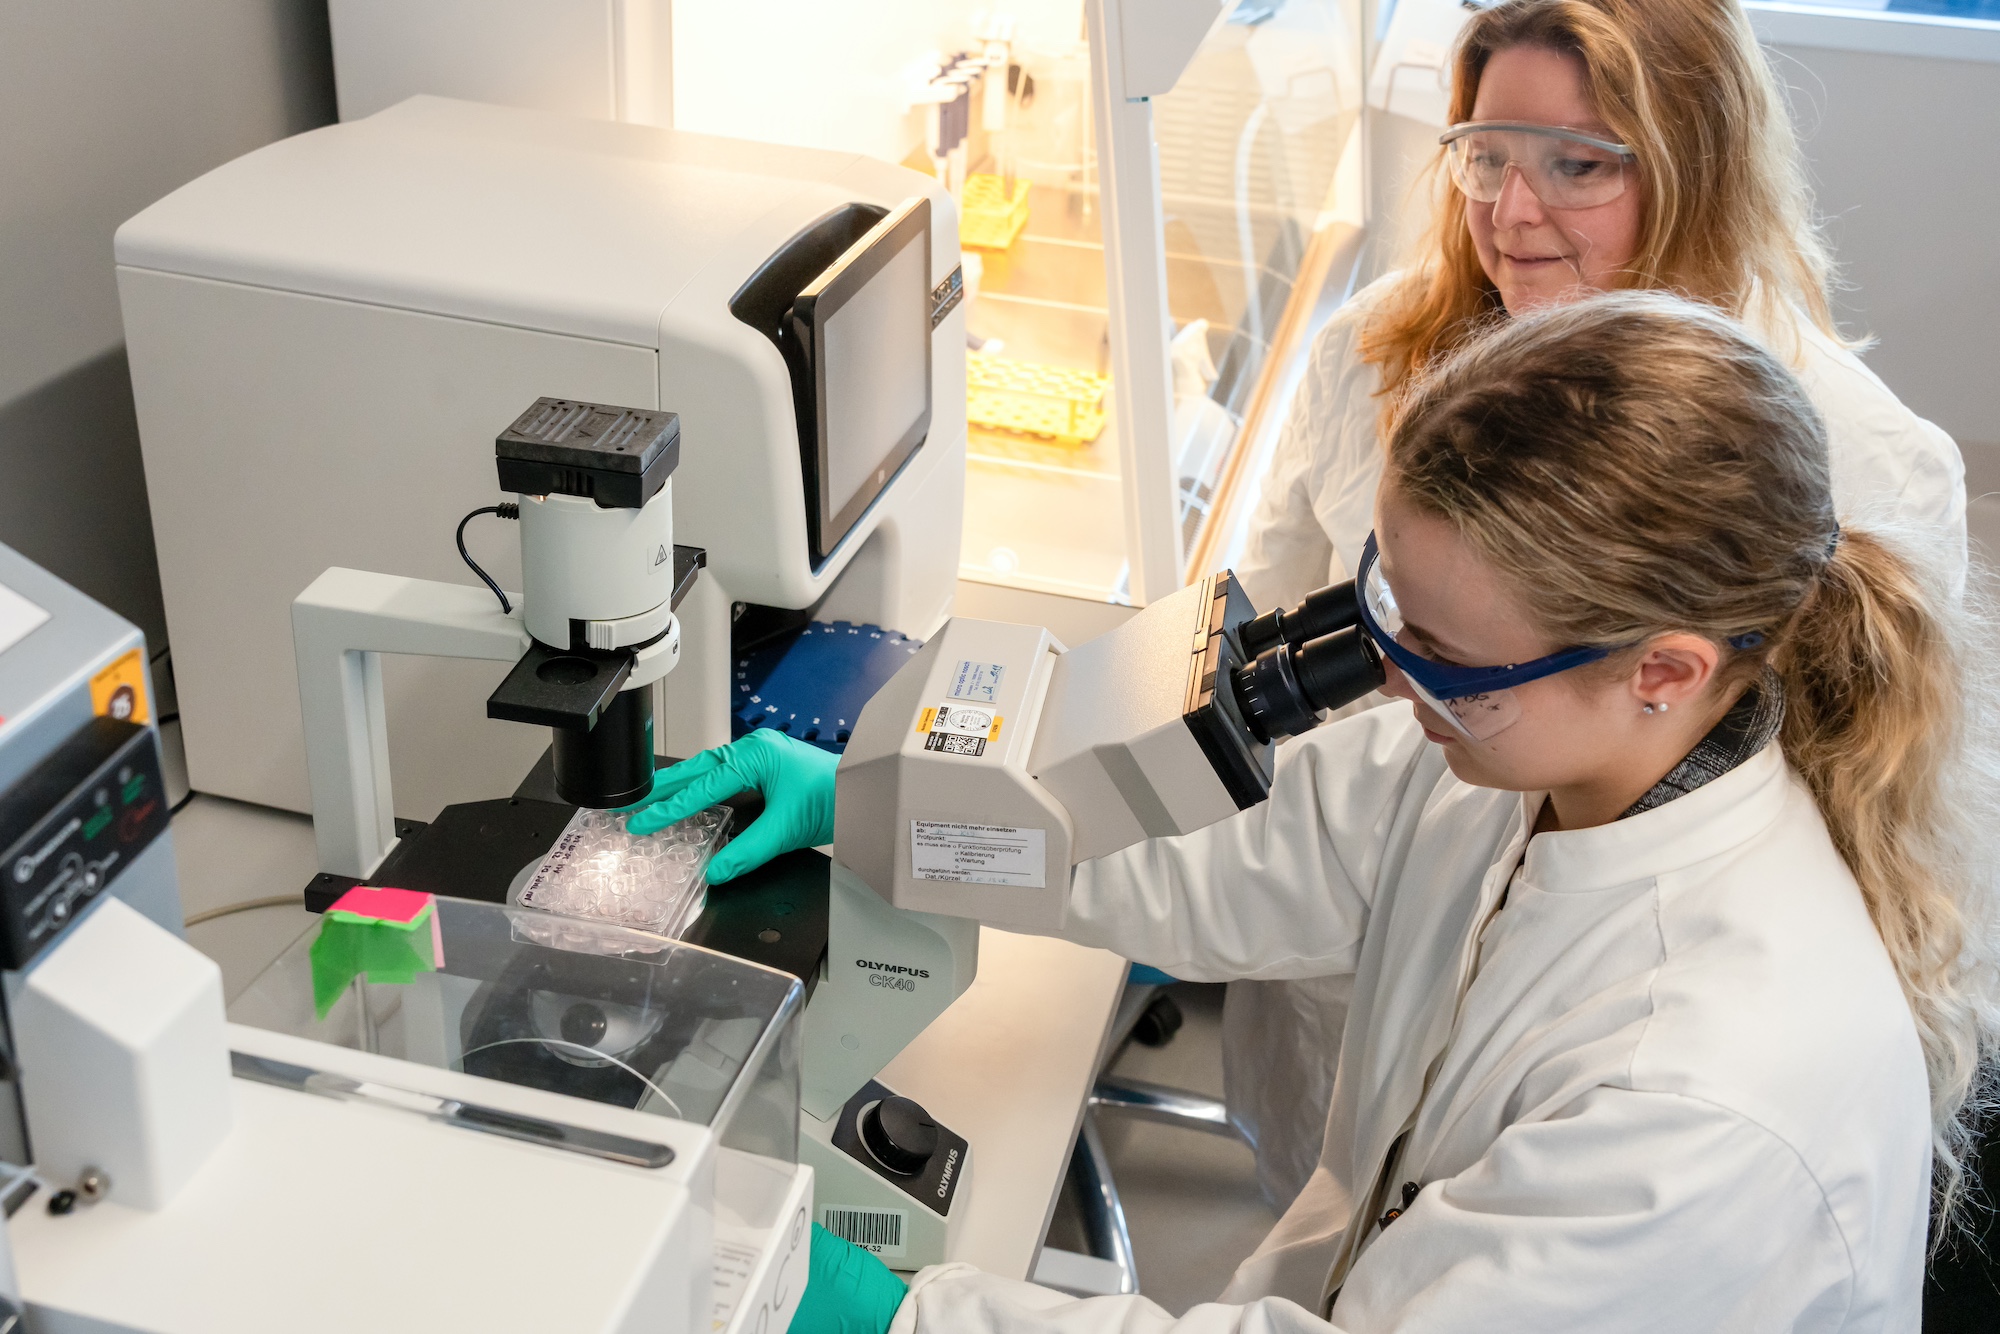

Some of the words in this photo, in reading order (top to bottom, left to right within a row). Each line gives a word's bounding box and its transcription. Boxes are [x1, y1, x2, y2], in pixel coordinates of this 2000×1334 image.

[916, 821, 950, 829] Equipment
[951, 823, 968, 831] nicht
[957, 844, 1022, 855] Funktionsüberprüfung
[960, 851, 995, 859] Kalibrierung
[960, 857, 985, 865] Wartung
[856, 959, 930, 979] OLYMPUS
[869, 973, 915, 992] CK40
[937, 1148, 959, 1199] OLYMPUS
